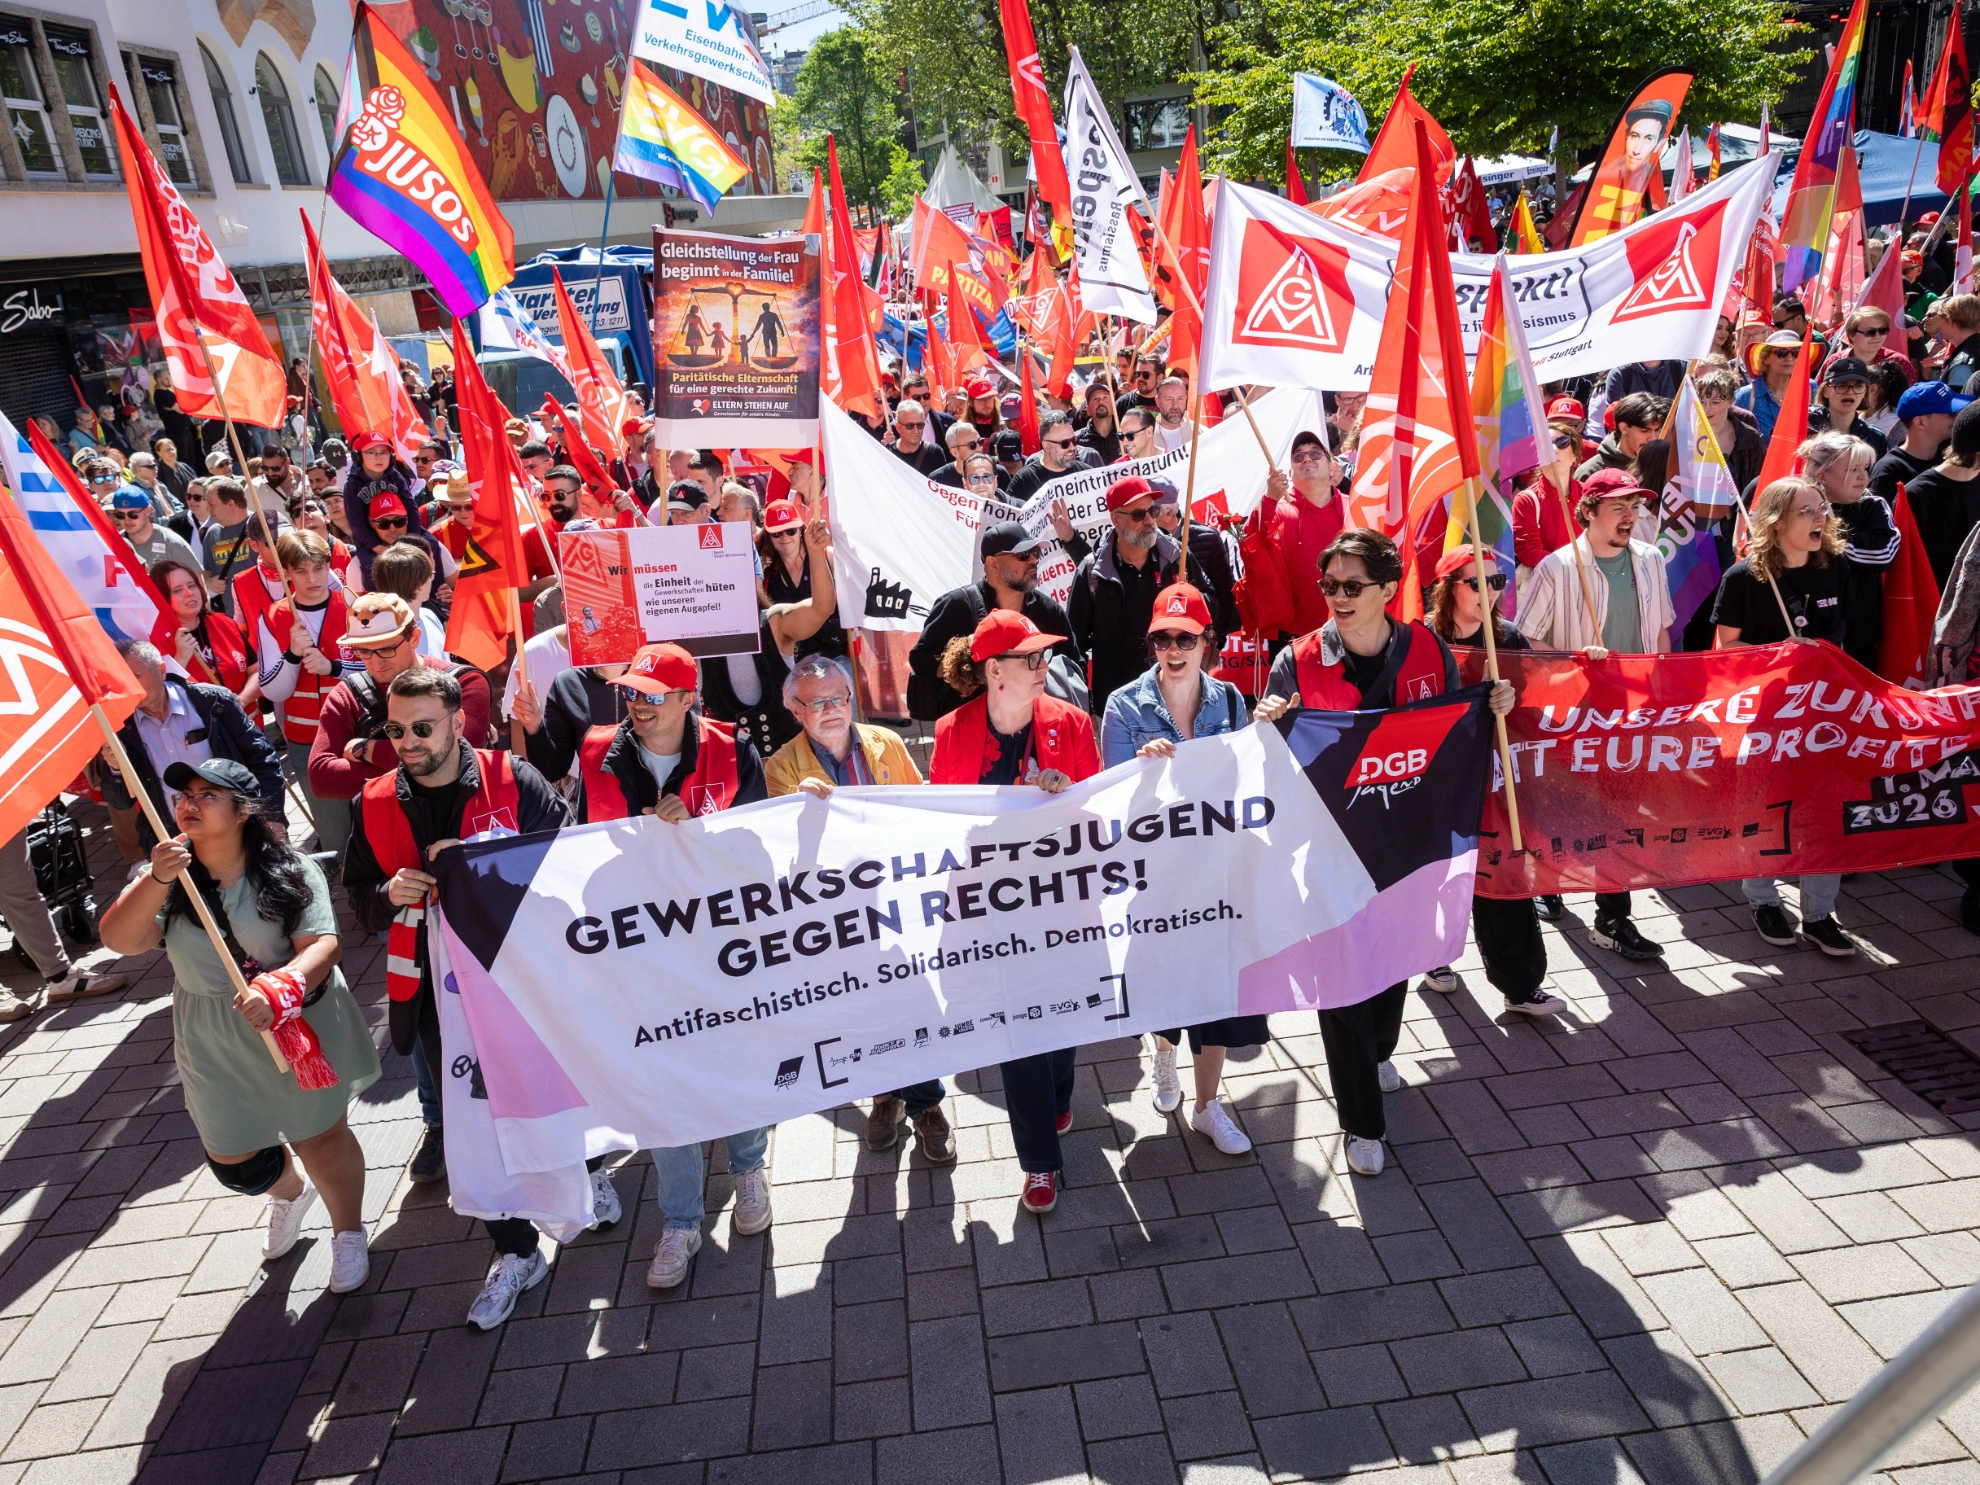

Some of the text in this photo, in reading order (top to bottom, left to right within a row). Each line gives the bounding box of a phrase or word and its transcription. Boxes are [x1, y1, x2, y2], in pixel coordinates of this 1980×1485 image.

[685, 28, 750, 63] Eisenbahn-
[644, 32, 769, 91] Verkehrsgewerkschaft
[365, 148, 479, 246] JUSOS
[660, 242, 799, 265] Gleichstellung der Frau
[661, 264, 794, 283] beginnt in der Familie!
[1, 289, 62, 334] Sabo
[672, 372, 798, 383] Paritätische Elternschaft
[669, 384, 797, 395] für eine gerechte Zukunft!
[712, 400, 789, 410] ELTERN STEHEN AUF
[927, 480, 979, 511] Gegen
[956, 510, 982, 532] Für
[608, 562, 677, 576] Wir müssen
[654, 577, 691, 588] Einheit
[654, 582, 735, 597] Gewerkschaften hüten
[645, 596, 695, 607] wie unseren
[645, 602, 721, 617] eigenen Augapfel!
[1538, 679, 1980, 733] UNSERE ZUKUNF
[1570, 735, 1722, 773] EURE
[1736, 722, 1972, 769] PROFITE
[1361, 748, 1428, 779] DGB
[1850, 789, 1958, 828] 2026
[565, 796, 1275, 955] GEWERKSCHAFTSJUGEND
[717, 858, 1148, 978] GEGEN RECHTS!
[633, 900, 1243, 1048] Antifaschistisch. Solidarisch. Demokratisch.
[1050, 1001, 1072, 1012] EVG
[777, 1071, 798, 1084] DGB
